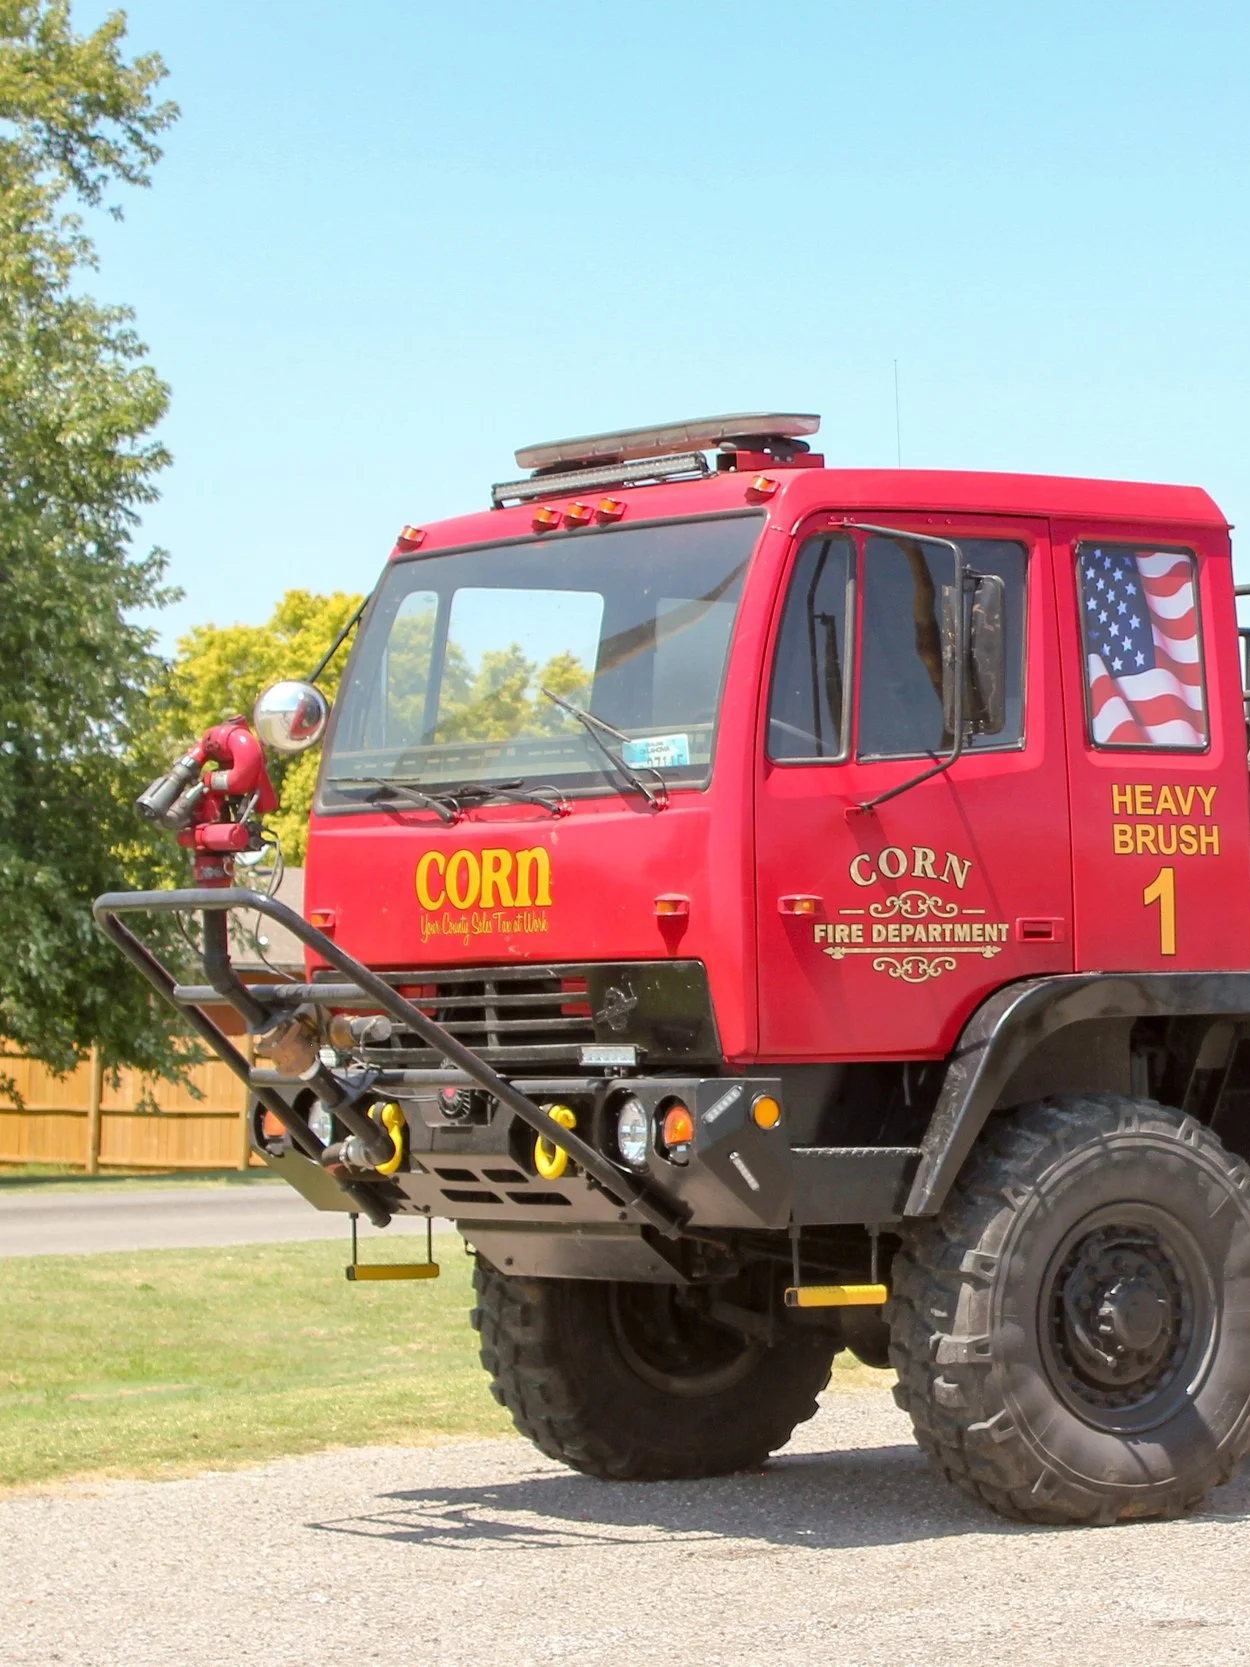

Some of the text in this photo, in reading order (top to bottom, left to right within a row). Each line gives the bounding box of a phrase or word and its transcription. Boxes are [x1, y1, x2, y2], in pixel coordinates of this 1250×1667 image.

[1111, 783, 1218, 816] HEAVY
[1112, 823, 1220, 855] BRUSH
[849, 845, 973, 890] CORN
[420, 909, 549, 947] Your County Sales Tax at Work
[1143, 866, 1176, 956] 1
[813, 923, 1010, 943] FIRE DEPARTMENT
